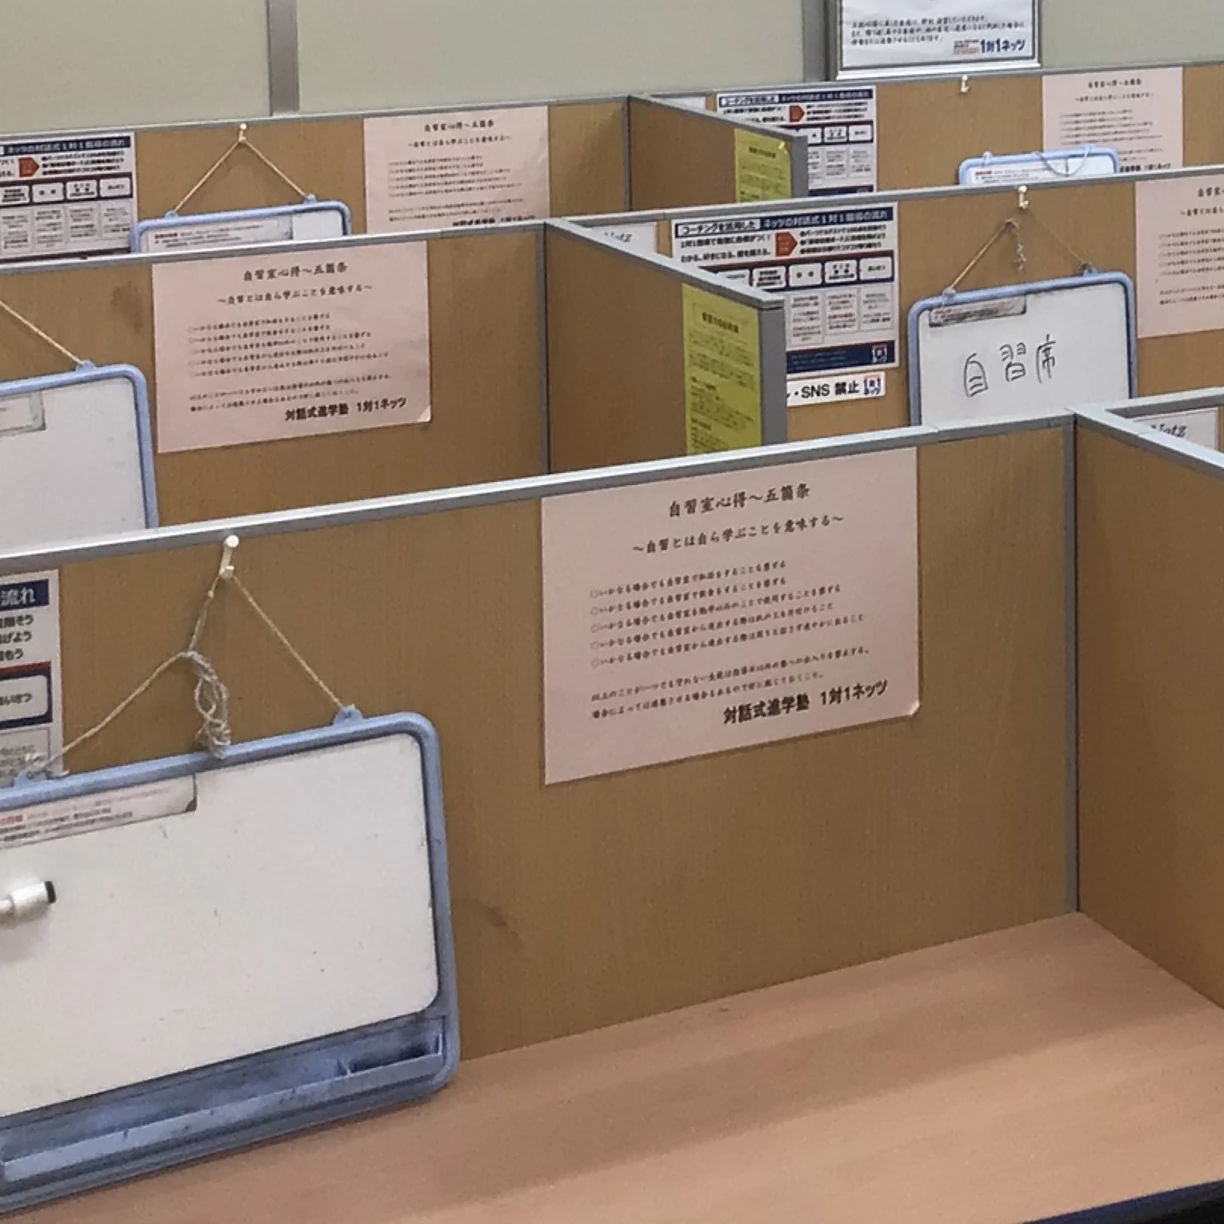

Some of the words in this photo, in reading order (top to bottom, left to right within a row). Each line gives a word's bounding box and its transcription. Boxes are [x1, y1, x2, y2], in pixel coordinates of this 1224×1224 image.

[963, 333, 1057, 398] 自習席
[668, 482, 810, 518] 自習室心得～五箇条
[723, 692, 809, 725] 対話式進学塾
[820, 680, 888, 707] 1対1ネッツ
